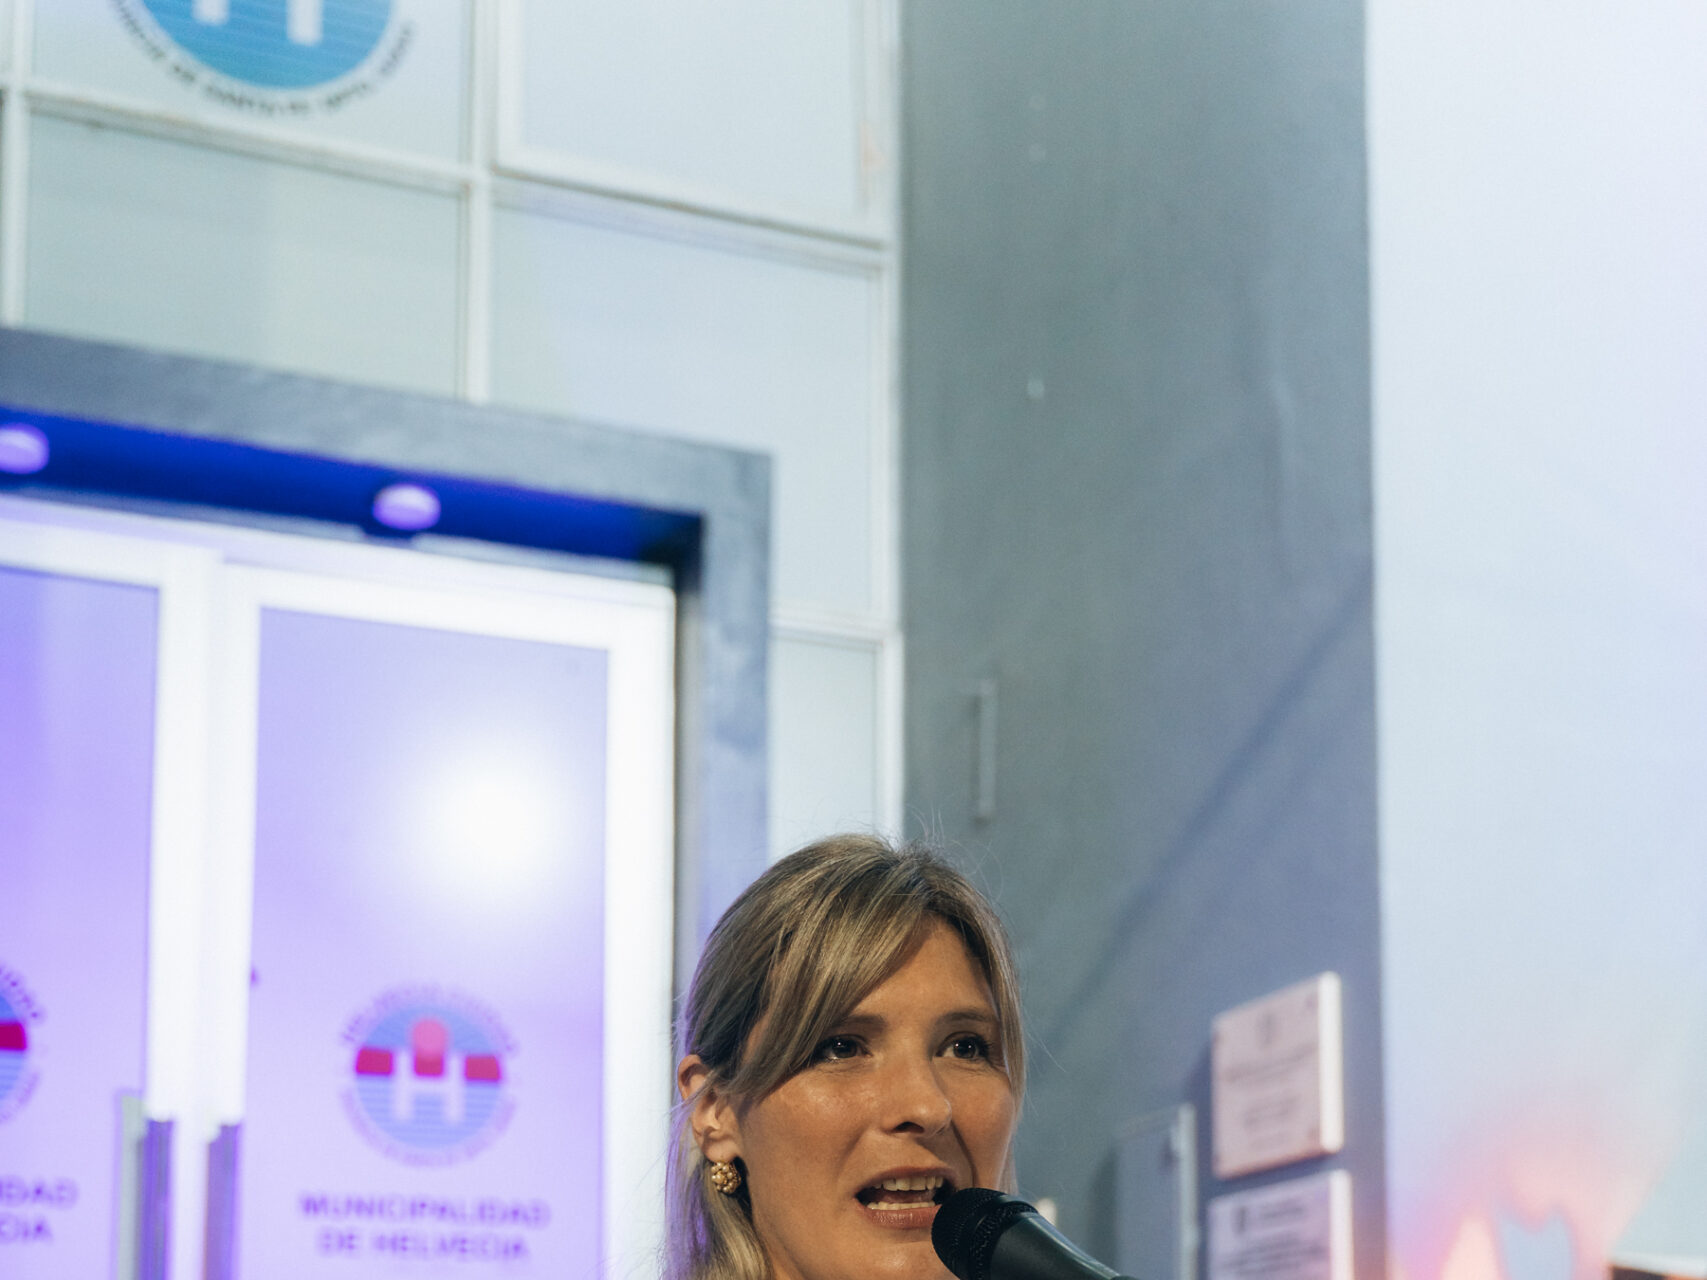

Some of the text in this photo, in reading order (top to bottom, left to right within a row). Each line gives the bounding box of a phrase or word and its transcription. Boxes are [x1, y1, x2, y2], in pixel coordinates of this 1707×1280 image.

[300, 1193, 551, 1228] MUNICIPALIDAD
[317, 1227, 530, 1262] DE HELVECIA
